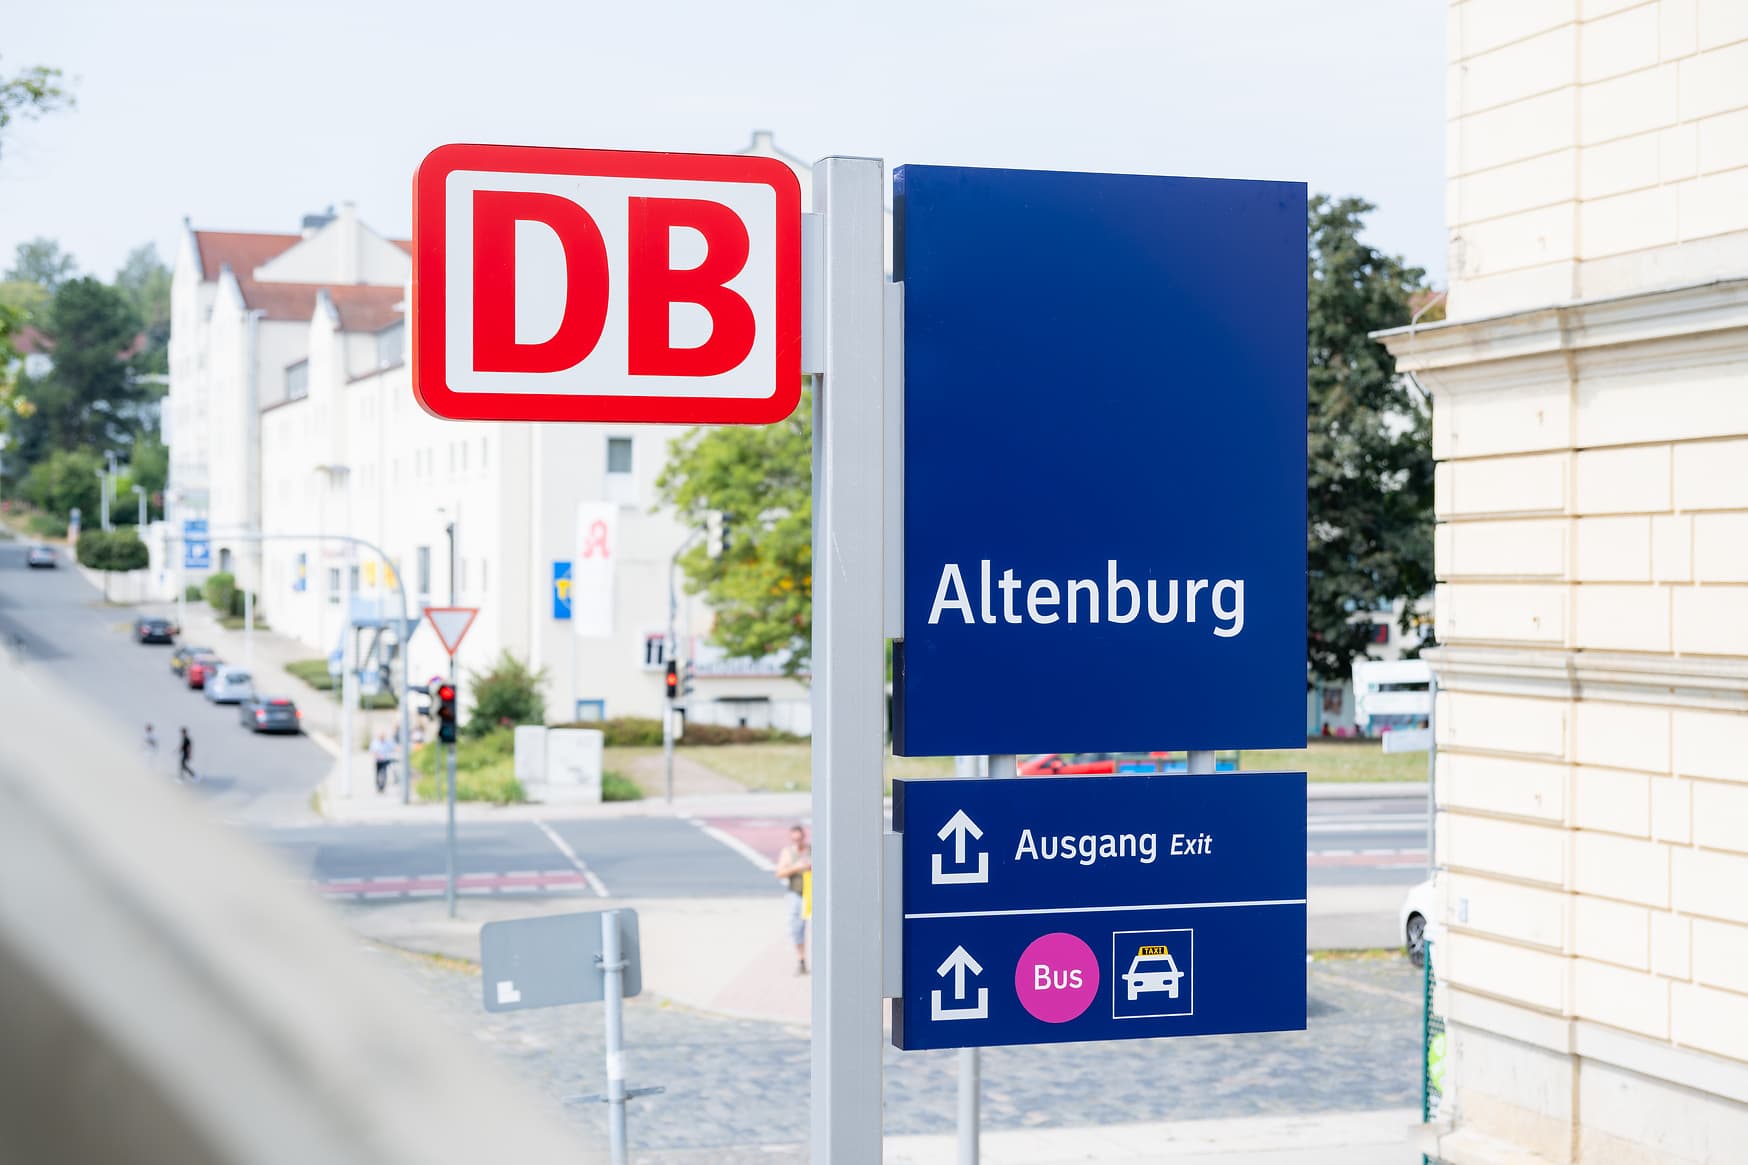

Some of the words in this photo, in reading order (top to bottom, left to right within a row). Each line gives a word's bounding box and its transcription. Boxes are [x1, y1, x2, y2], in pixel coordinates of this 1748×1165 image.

[473, 190, 756, 376] DB
[928, 560, 1245, 637] Altenburg
[1015, 830, 1158, 865] Ausgang
[1170, 833, 1213, 856] Exit
[1034, 964, 1083, 990] Bus
